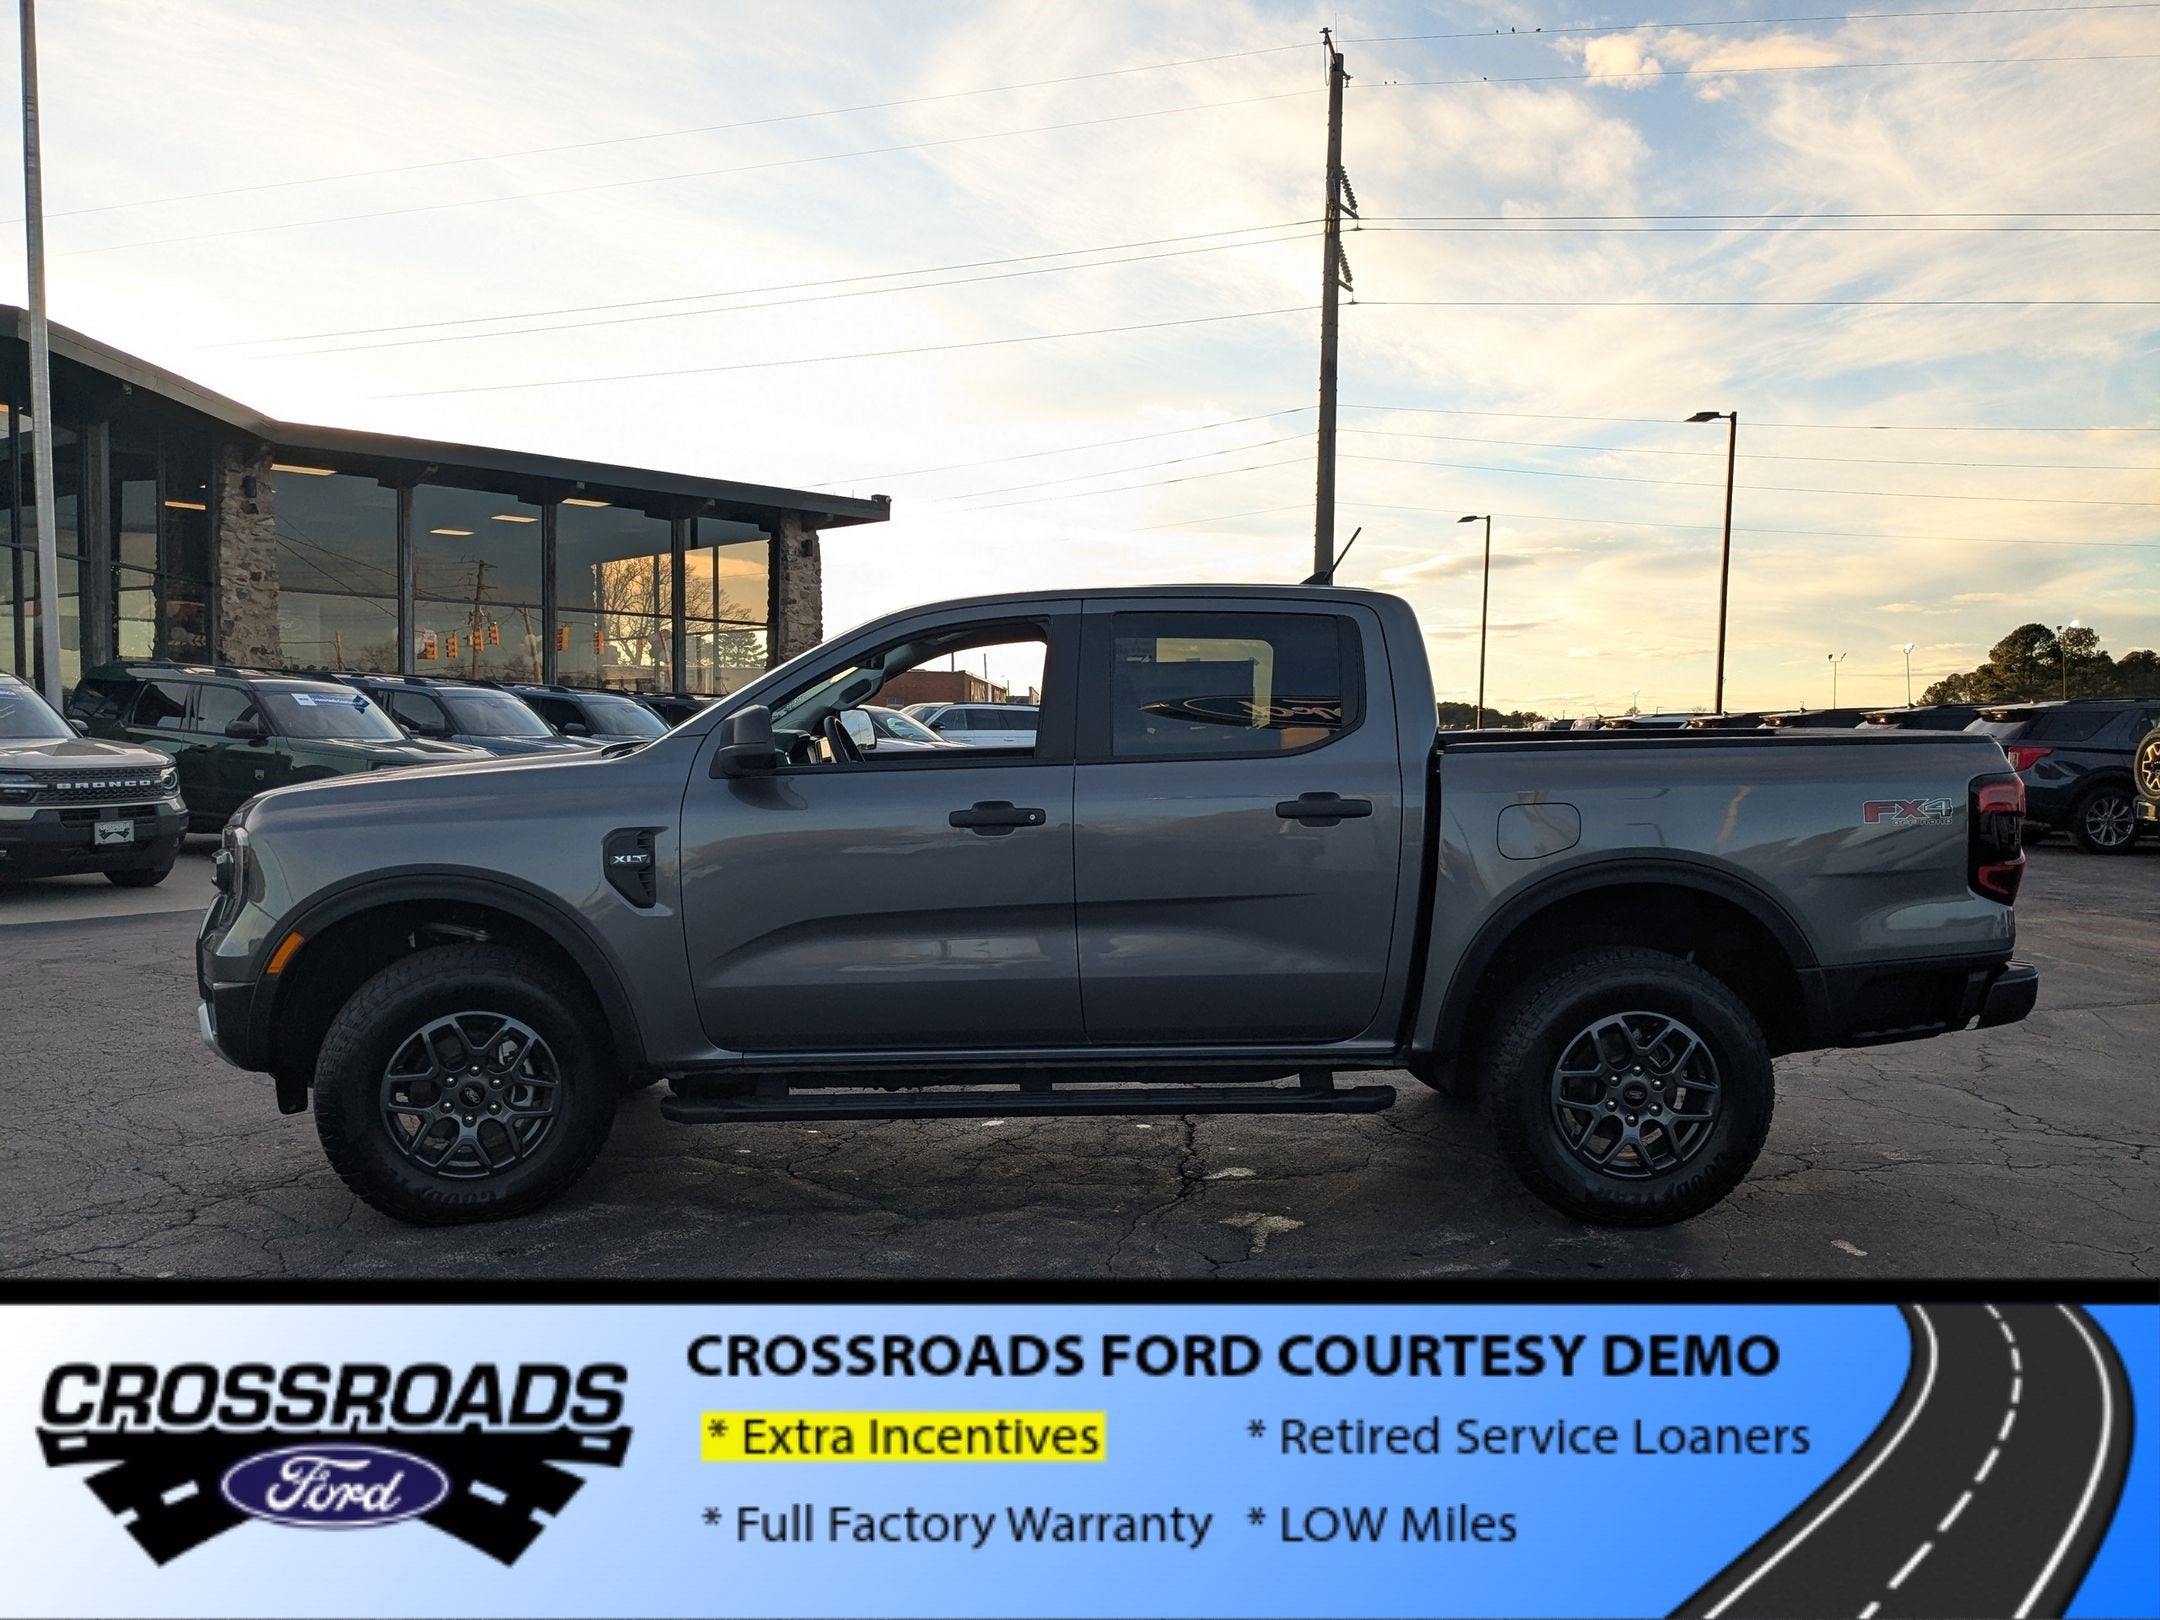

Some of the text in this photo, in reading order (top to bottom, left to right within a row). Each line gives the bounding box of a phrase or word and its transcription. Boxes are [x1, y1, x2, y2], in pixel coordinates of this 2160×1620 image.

[56, 780, 151, 789] BRONCO
[1862, 797, 1953, 824] FX4
[611, 854, 650, 865] XLT
